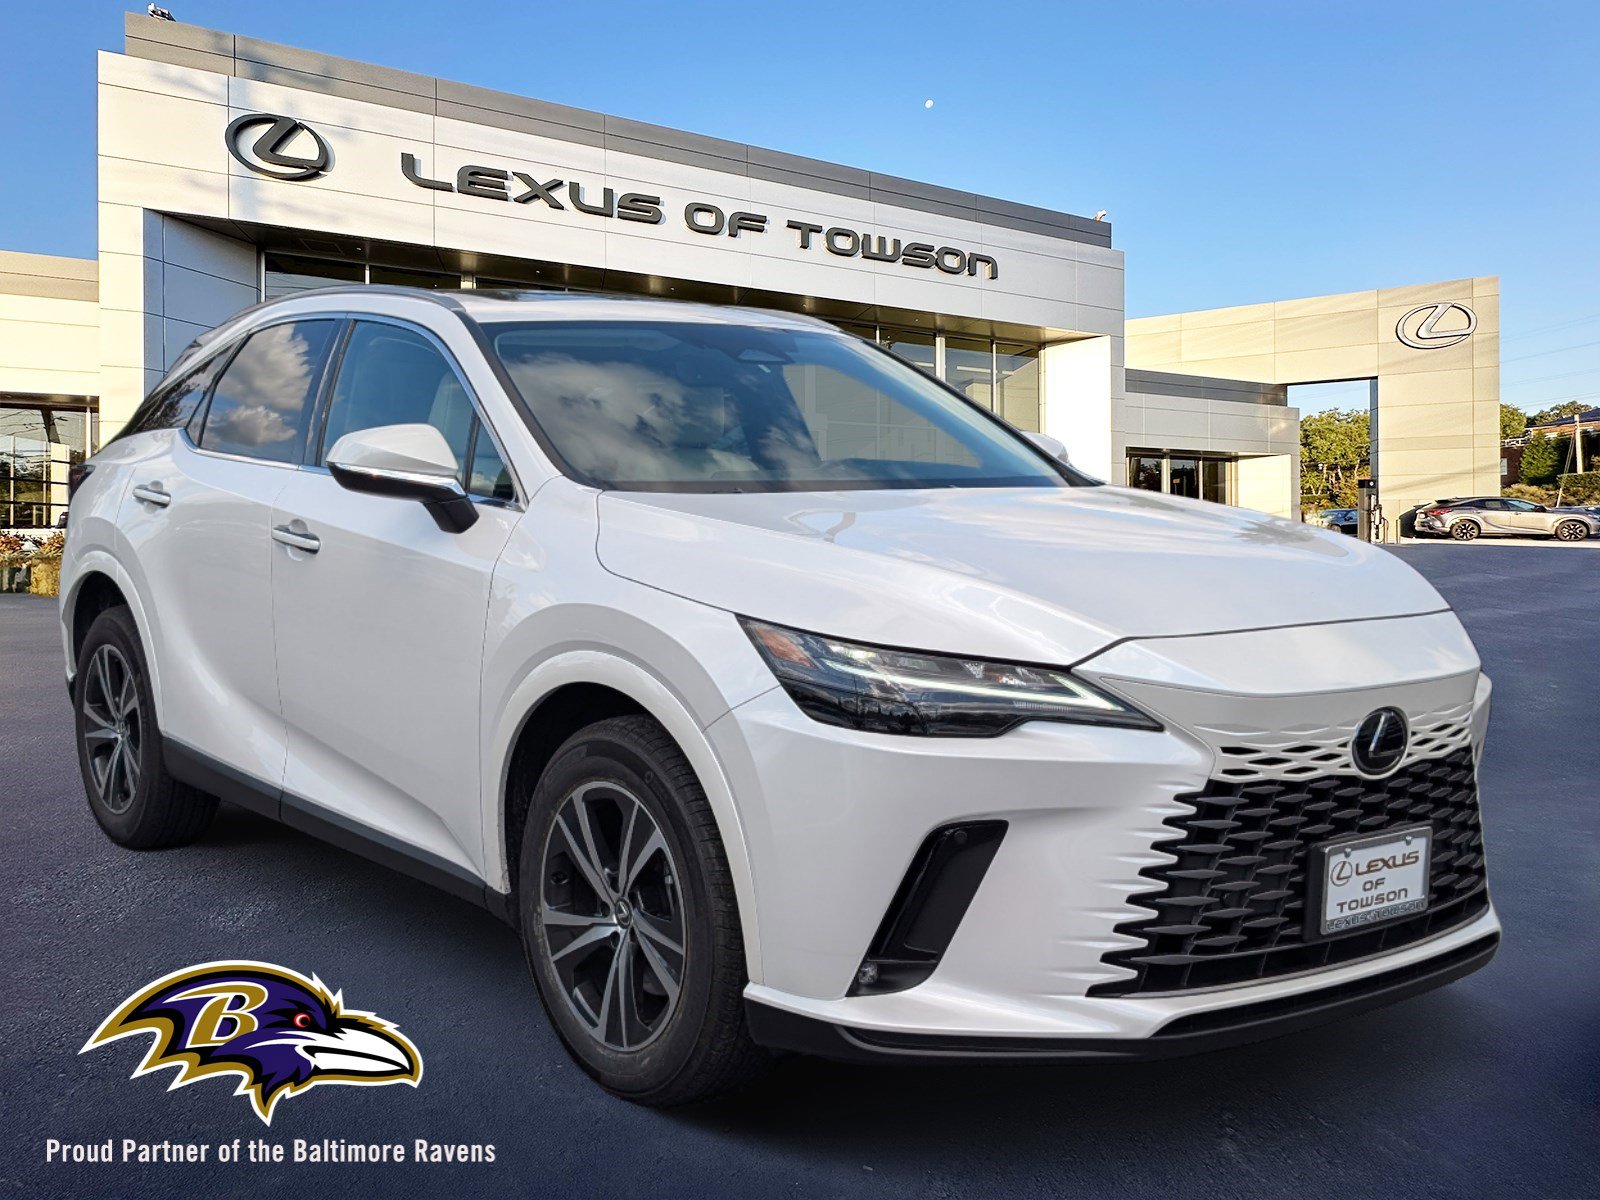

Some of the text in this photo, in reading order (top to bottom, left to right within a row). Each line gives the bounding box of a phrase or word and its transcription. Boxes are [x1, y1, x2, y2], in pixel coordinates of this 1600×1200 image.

[401, 152, 999, 281] LEXUS OF TOWSON
[1355, 850, 1420, 876] LEXUS
[1362, 877, 1386, 892] OF
[1336, 887, 1408, 913] TOWSON
